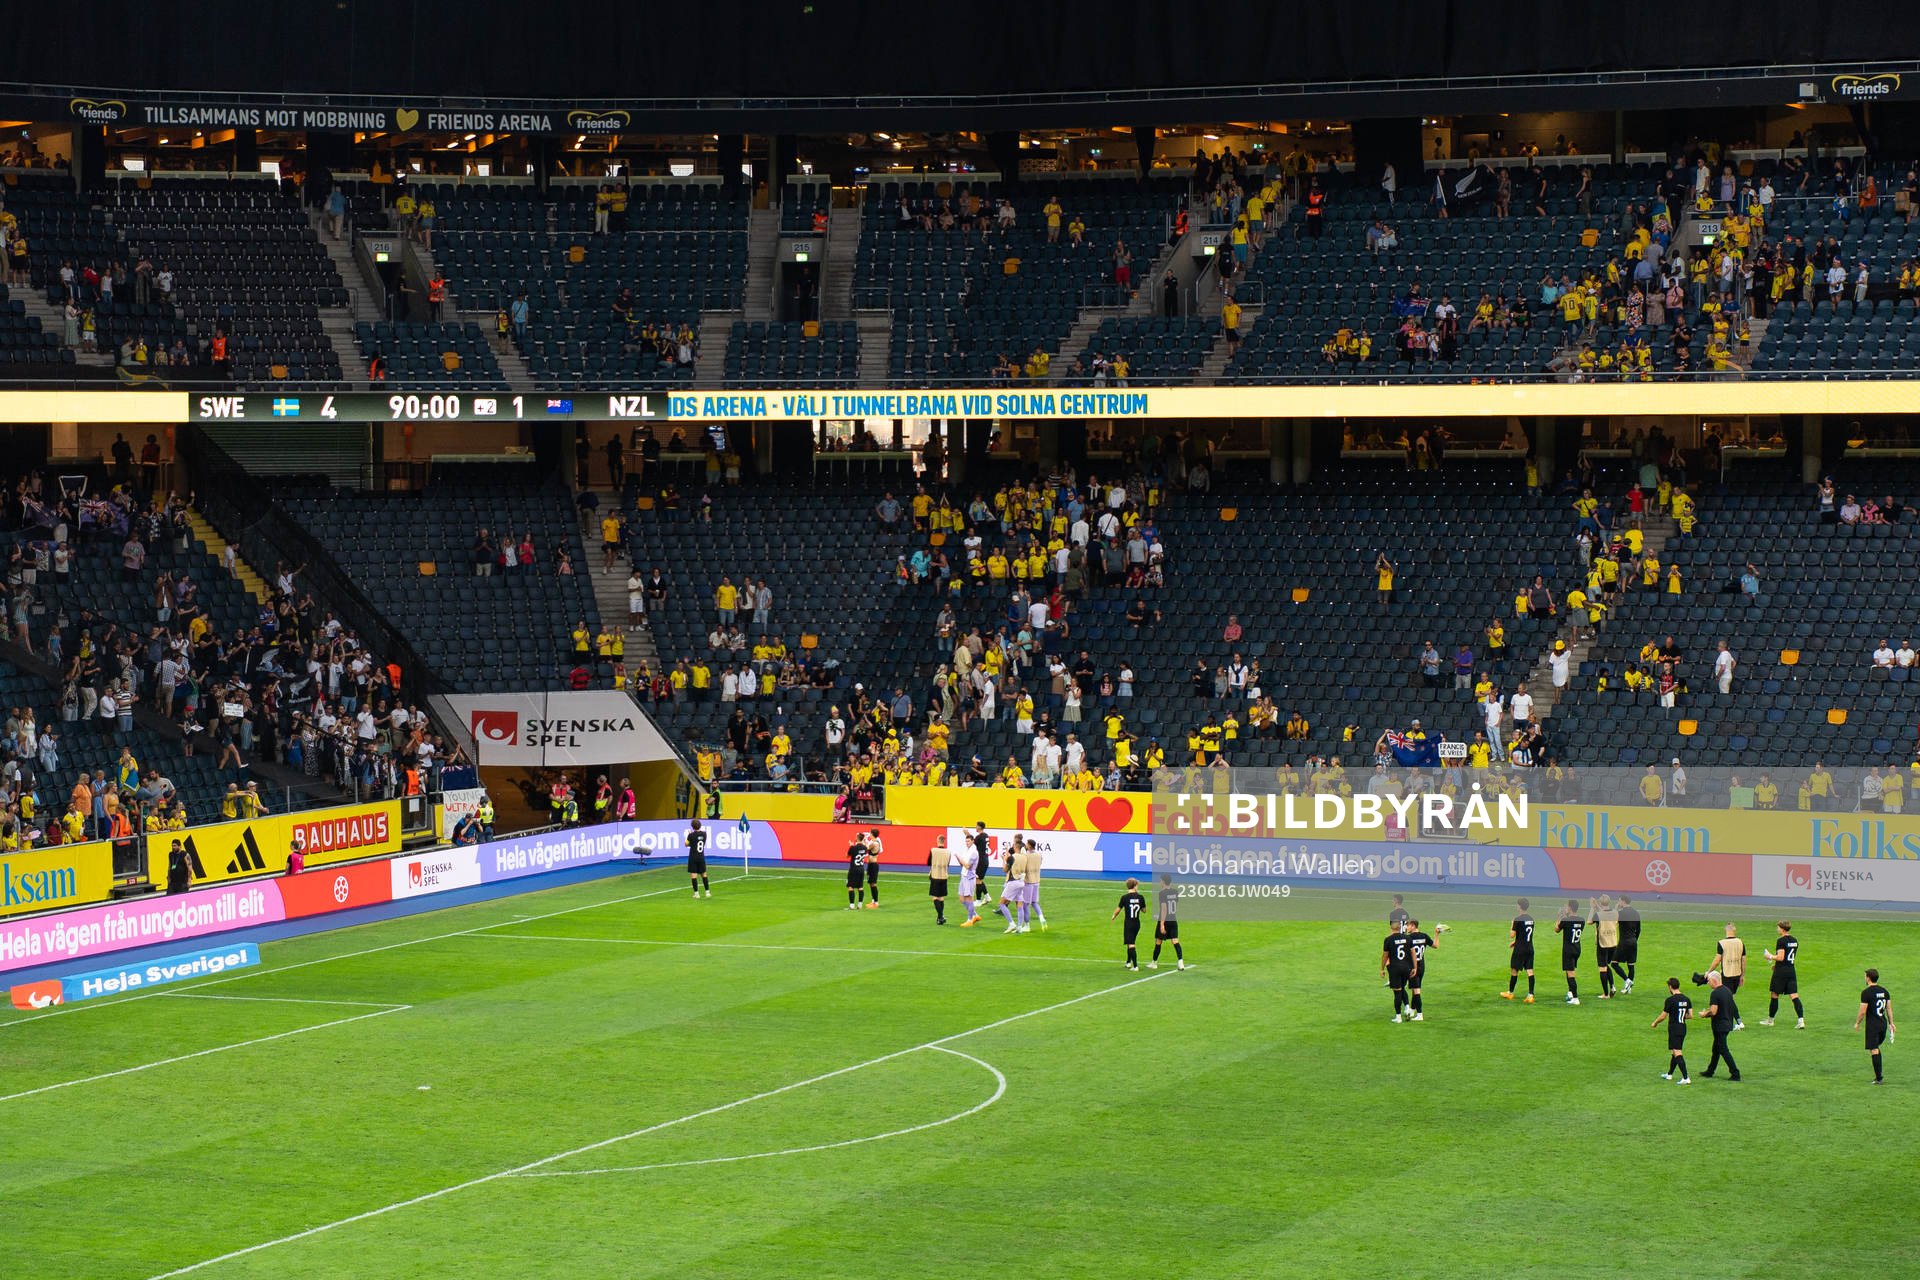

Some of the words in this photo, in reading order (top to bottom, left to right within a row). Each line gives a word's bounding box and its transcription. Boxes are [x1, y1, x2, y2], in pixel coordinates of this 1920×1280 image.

[1841, 81, 1889, 95] friends
[78, 105, 118, 120] friends
[144, 107, 260, 125] TILLSAMMANS
[266, 110, 298, 127] MOT
[303, 111, 386, 129] MOBBNING
[428, 113, 494, 130] FRIENDS
[499, 115, 552, 131] ARENA
[576, 116, 621, 129] friends
[1701, 224, 1719, 233] 213
[374, 243, 390, 251] 216
[794, 243, 810, 251] 215
[1203, 236, 1218, 244] 214
[200, 397, 245, 418] SWE
[320, 396, 337, 419] 4
[389, 396, 460, 419] 90:00
[476, 401, 494, 414] +2
[512, 396, 523, 418] 1
[609, 396, 655, 417] NZL
[703, 396, 767, 417] ARENA
[783, 394, 827, 417] VÄLJ
[832, 395, 957, 416] TUNNELBANA
[962, 395, 992, 415] VID
[997, 394, 1056, 415] SOLNA
[1060, 394, 1148, 415] CENTRUM
[526, 718, 635, 732] SVENSKA
[526, 734, 581, 747] SPEL
[1016, 799, 1078, 831] ICA
[295, 813, 388, 850] BAUHAUS
[1537, 810, 1711, 853] Folksam
[496, 845, 526, 872] Hela
[528, 841, 568, 869] vägen
[570, 833, 595, 860] från
[597, 827, 680, 857] ungdom
[697, 840, 704, 853] 8
[1133, 842, 1187, 867] Hela
[1194, 844, 1273, 873] vägen
[1447, 851, 1479, 877] till
[1483, 853, 1525, 879] elit
[423, 862, 453, 876] SVENSKA
[1816, 870, 1874, 881] SVENSKA
[0, 863, 76, 907] ksam
[424, 876, 440, 887] SPEL
[1816, 881, 1846, 891] SPEL
[1129, 904, 1140, 918] 17
[1167, 900, 1177, 915] 10
[0, 928, 42, 960] Hela
[44, 921, 101, 955] vägen
[104, 910, 138, 942] från
[141, 901, 214, 938] ungdom
[216, 893, 236, 922] till
[238, 888, 265, 917] elit
[1525, 926, 1533, 942] 7
[1571, 928, 1582, 943] 19
[1397, 944, 1405, 960] 6
[1787, 948, 1795, 964] 4
[82, 971, 142, 996] Heja
[146, 949, 247, 984] Sverige!
[1876, 999, 1887, 1017] 21
[1678, 1008, 1686, 1024] 11
